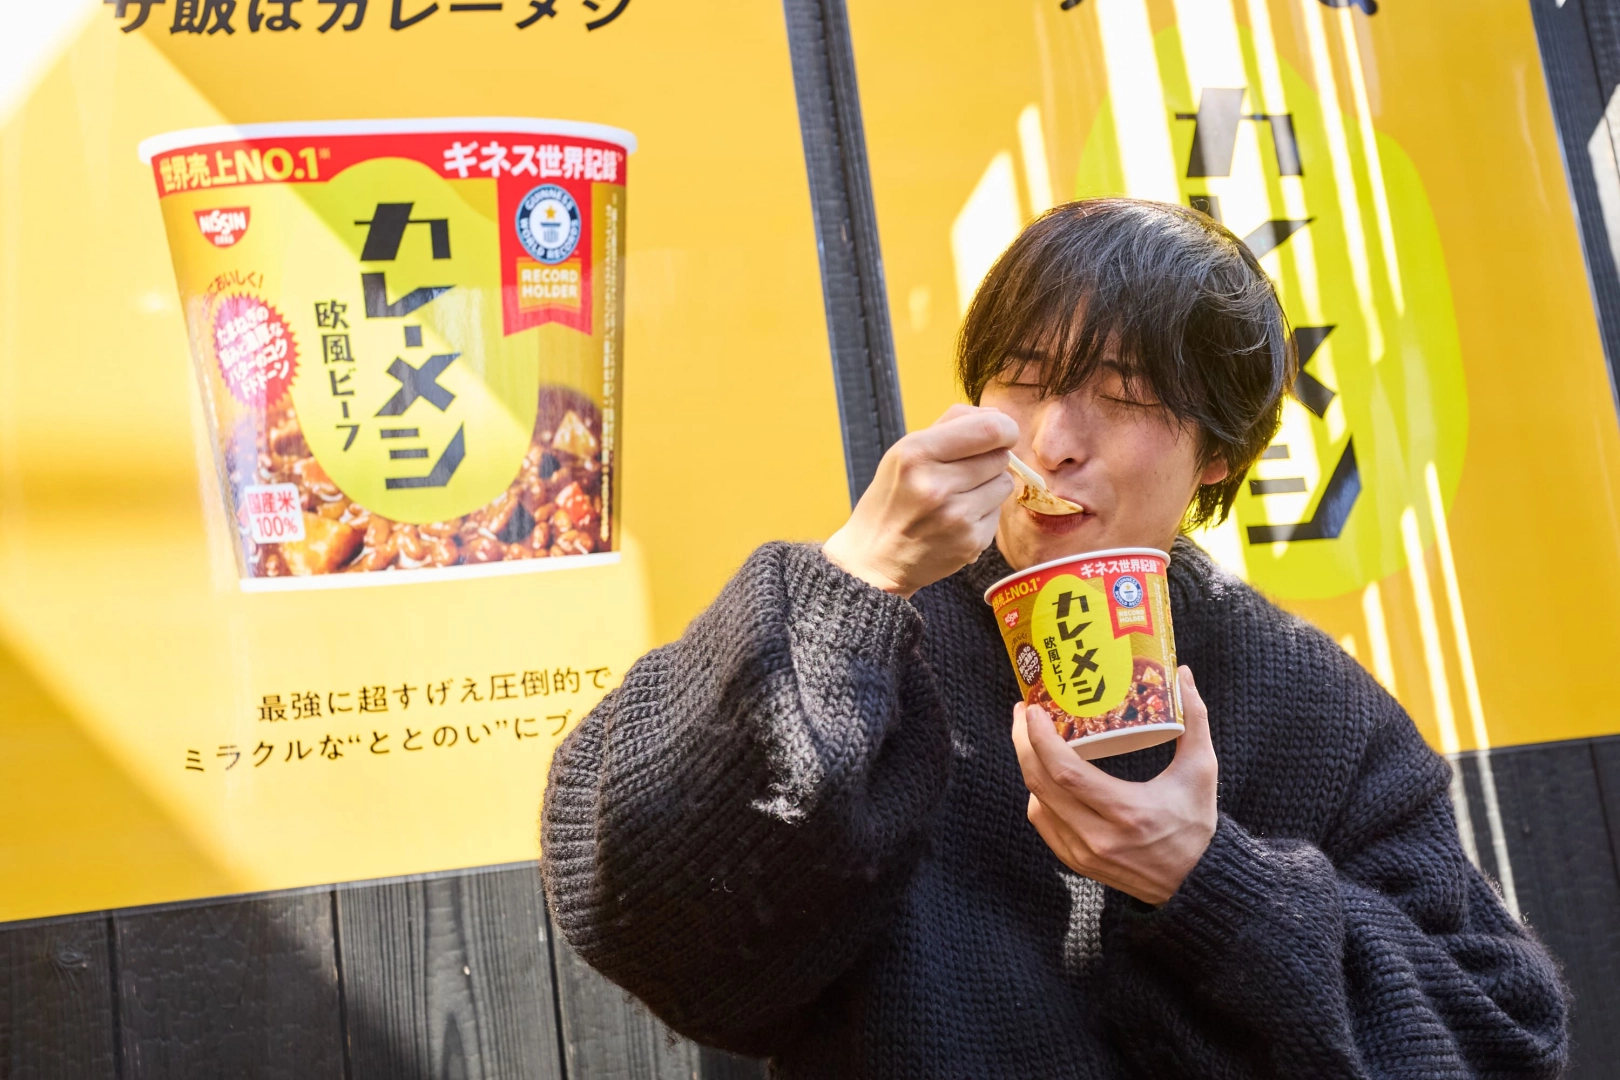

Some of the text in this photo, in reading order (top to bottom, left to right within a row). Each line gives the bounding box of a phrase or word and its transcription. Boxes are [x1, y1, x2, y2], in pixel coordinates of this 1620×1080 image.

[199, 209, 246, 236] NISSIN
[521, 268, 578, 283] RECORD
[522, 284, 578, 299] HOLDER
[354, 201, 466, 491] カレーメシ
[314, 300, 360, 453] 欧風ビーフ
[247, 491, 296, 514] 国産米
[256, 515, 298, 537] 100%
[1043, 636, 1067, 696] 欧風ビーフ
[1052, 590, 1106, 707] カレーメシ
[257, 667, 612, 722] 最強に超すげえ圧倒的で
